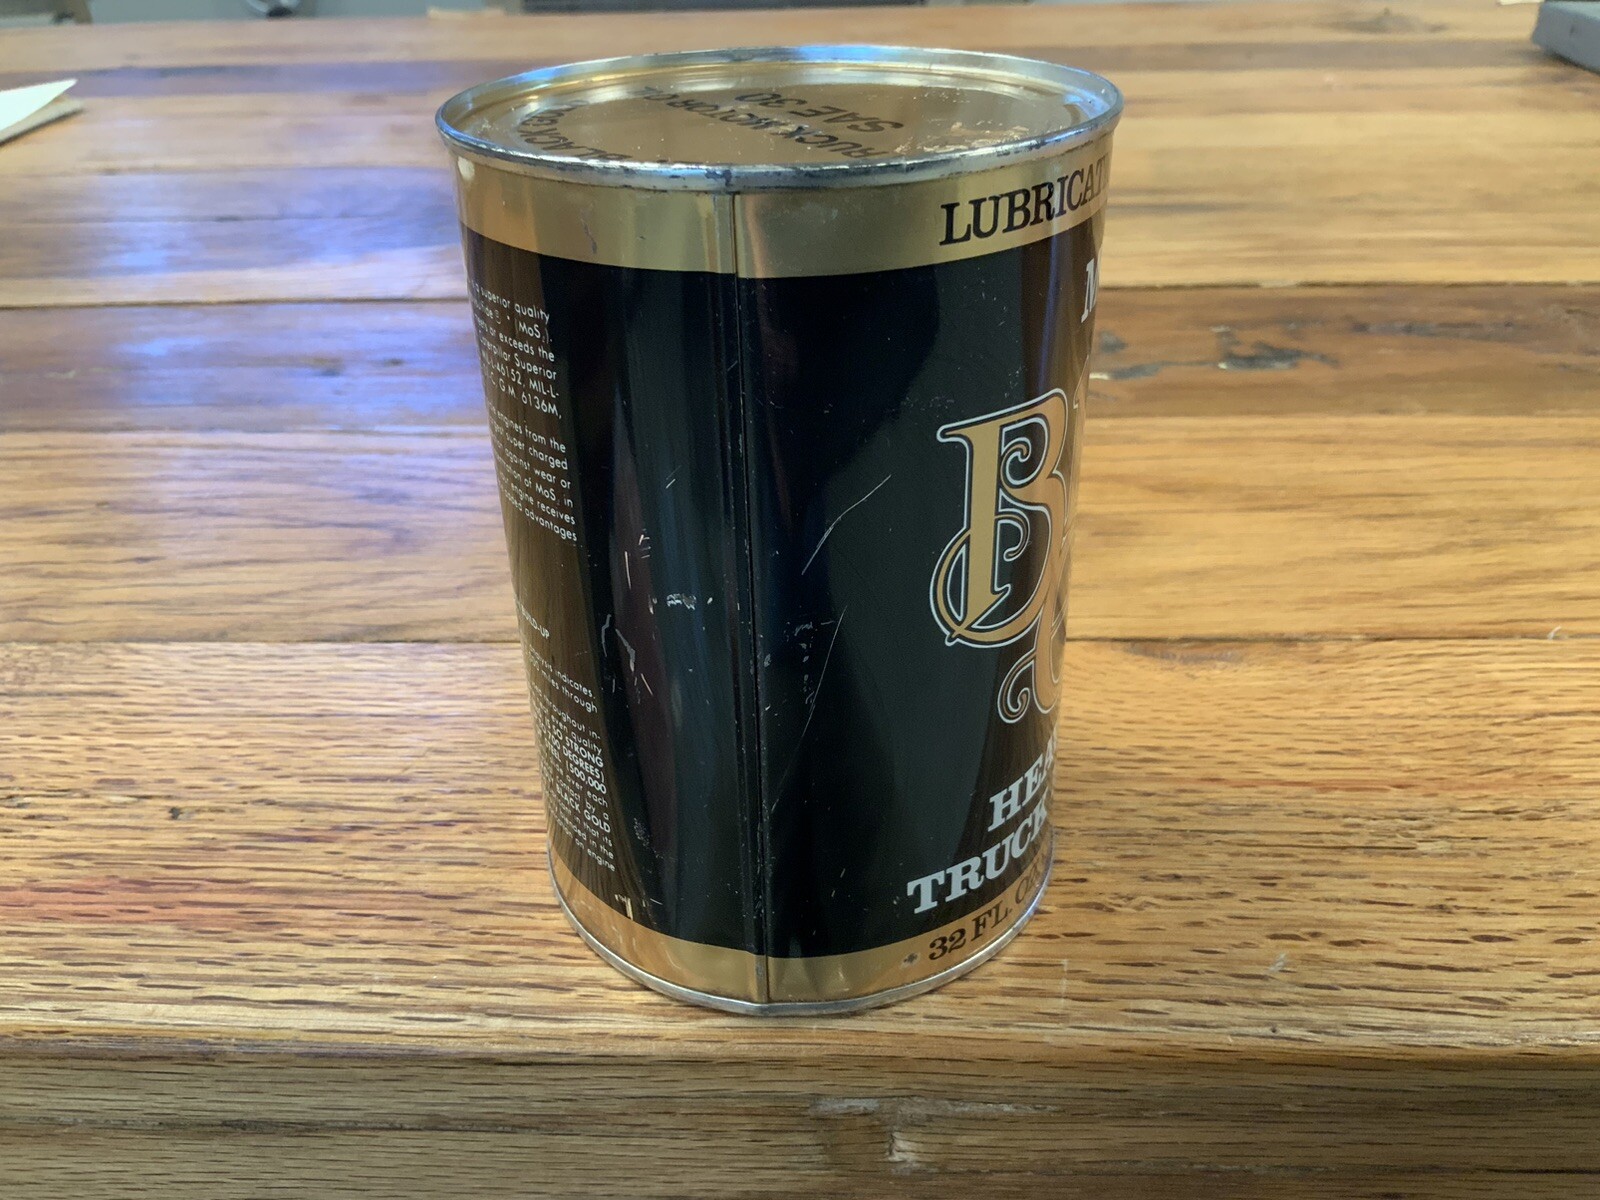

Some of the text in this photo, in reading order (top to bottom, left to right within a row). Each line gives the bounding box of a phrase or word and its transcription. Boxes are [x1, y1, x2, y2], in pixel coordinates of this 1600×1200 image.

[735, 92, 904, 133] SAE 30
[770, 124, 888, 159] RUCK
[514, 303, 550, 326] quality
[499, 332, 535, 356] exceeds
[538, 344, 555, 362] the
[514, 353, 557, 380] Superior
[529, 378, 560, 399] MIL-L-
[521, 391, 562, 420] 6136M,
[525, 424, 547, 445] from
[549, 436, 567, 454] the
[528, 446, 568, 471] charged
[524, 477, 532, 489] of
[563, 493, 574, 508] in
[533, 467, 557, 484] wear
[560, 479, 571, 490] or
[510, 482, 535, 506] engine
[537, 500, 576, 526] receives
[524, 507, 577, 542] advantages
[562, 685, 598, 714] through
[551, 714, 568, 734] even
[570, 731, 602, 756] quality
[552, 724, 564, 741] SO
[564, 736, 604, 769] STRONG
[588, 727, 601, 741] in-
[562, 745, 606, 784] DEGREES)
[566, 774, 583, 792] over
[586, 789, 609, 808] each
[555, 783, 581, 814] BLACK
[583, 809, 611, 834] GOLD
[585, 799, 596, 815] by
[602, 811, 610, 822] a
[583, 817, 600, 838] that
[602, 833, 613, 848] its
[575, 838, 616, 873] on engine
[589, 836, 597, 848] in
[599, 843, 615, 861] the
[929, 928, 966, 961] 32
